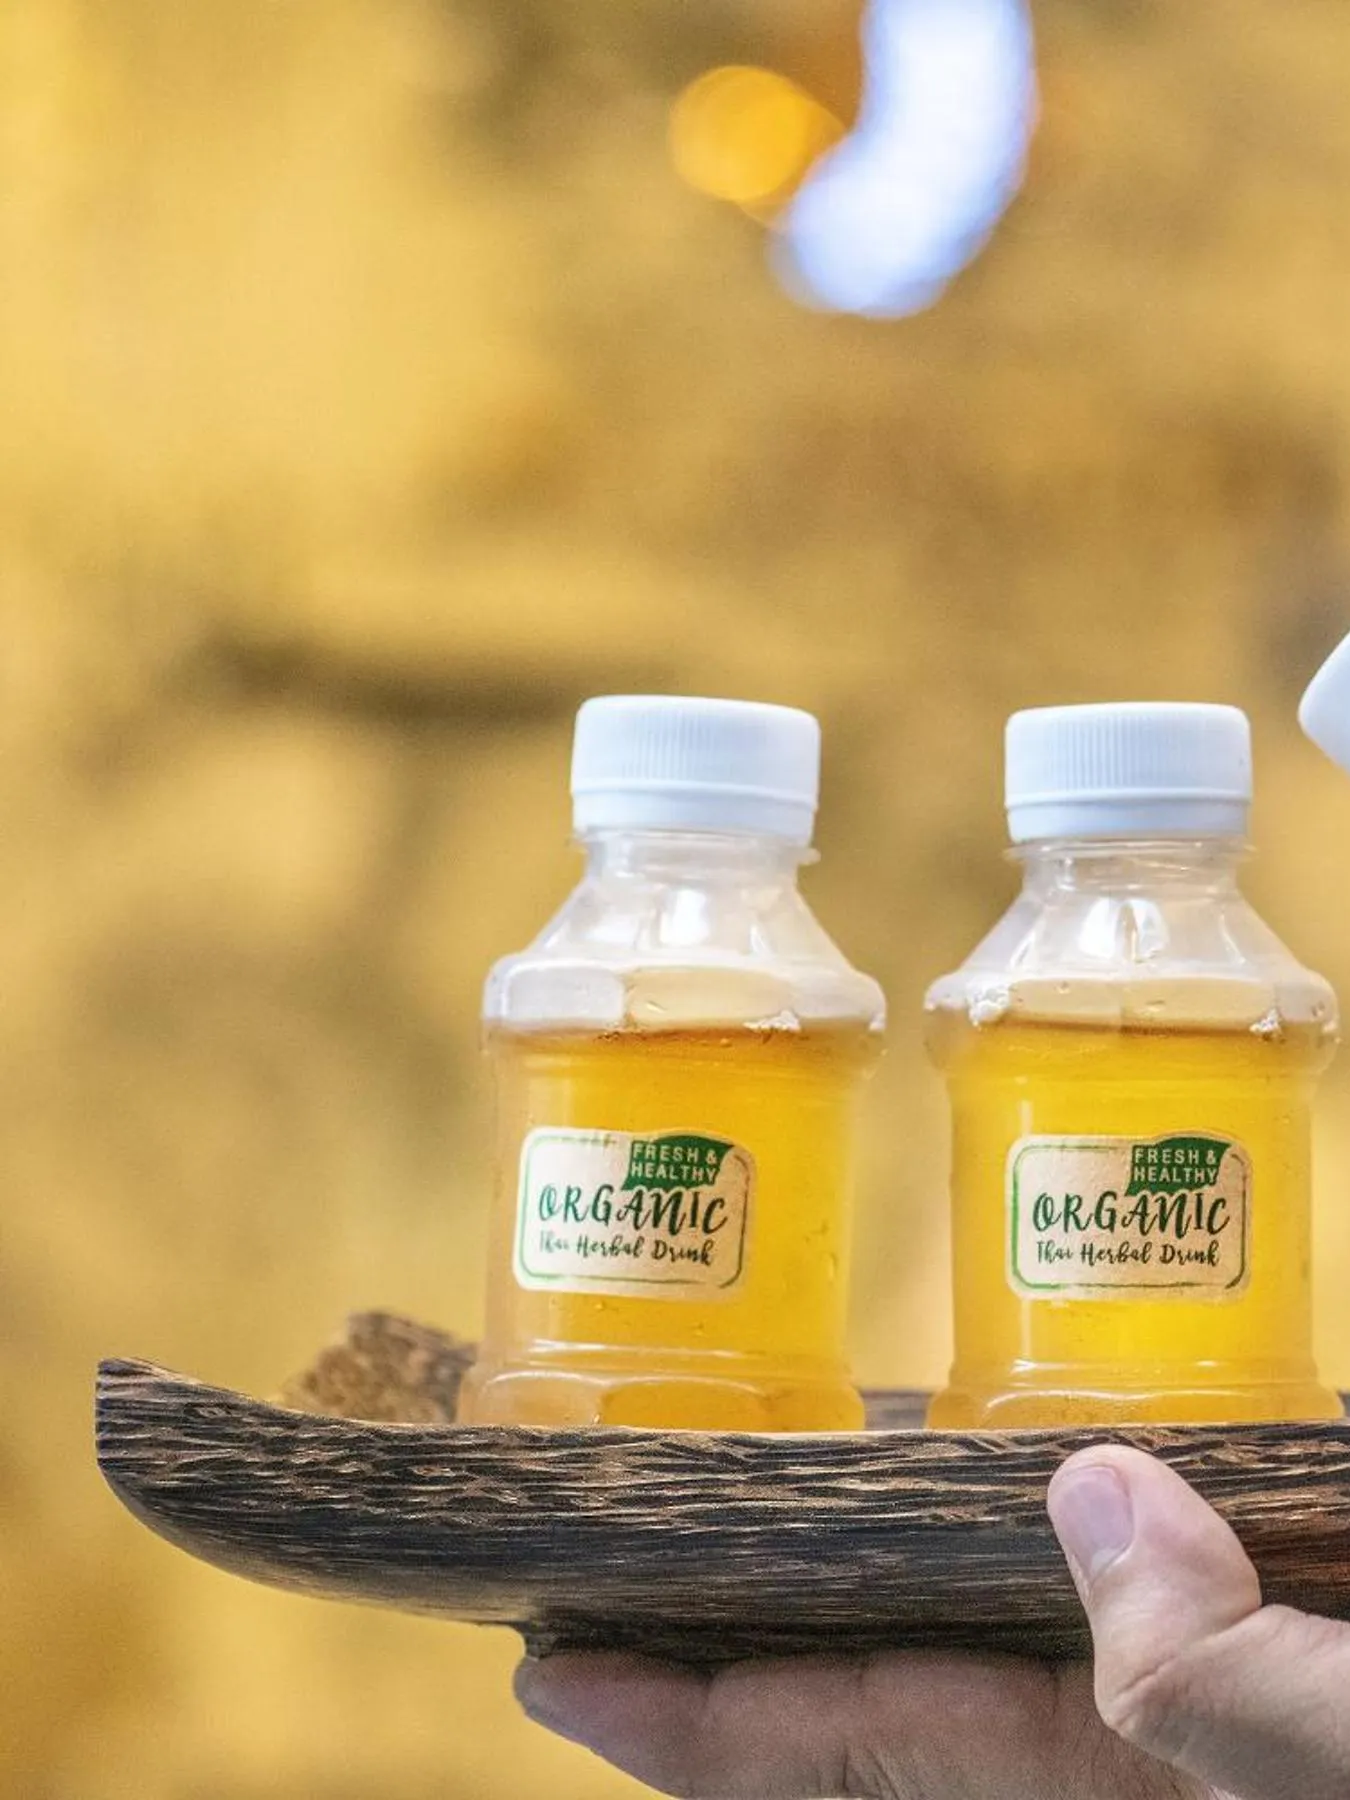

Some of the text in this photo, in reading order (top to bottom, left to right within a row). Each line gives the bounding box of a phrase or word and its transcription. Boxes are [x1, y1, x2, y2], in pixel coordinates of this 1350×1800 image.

[632, 1143, 717, 1163] FRESH &
[1134, 1149, 1216, 1165] FRESH &
[631, 1162, 717, 1182] HEALTHY
[1134, 1166, 1217, 1184] HEALTHY
[539, 1184, 728, 1236] ORGANIC
[1032, 1190, 1230, 1239] ORGANIC
[576, 1233, 645, 1259] Herbal
[651, 1240, 714, 1266] Drink
[1037, 1239, 1220, 1267] Thai Herbal Drink
